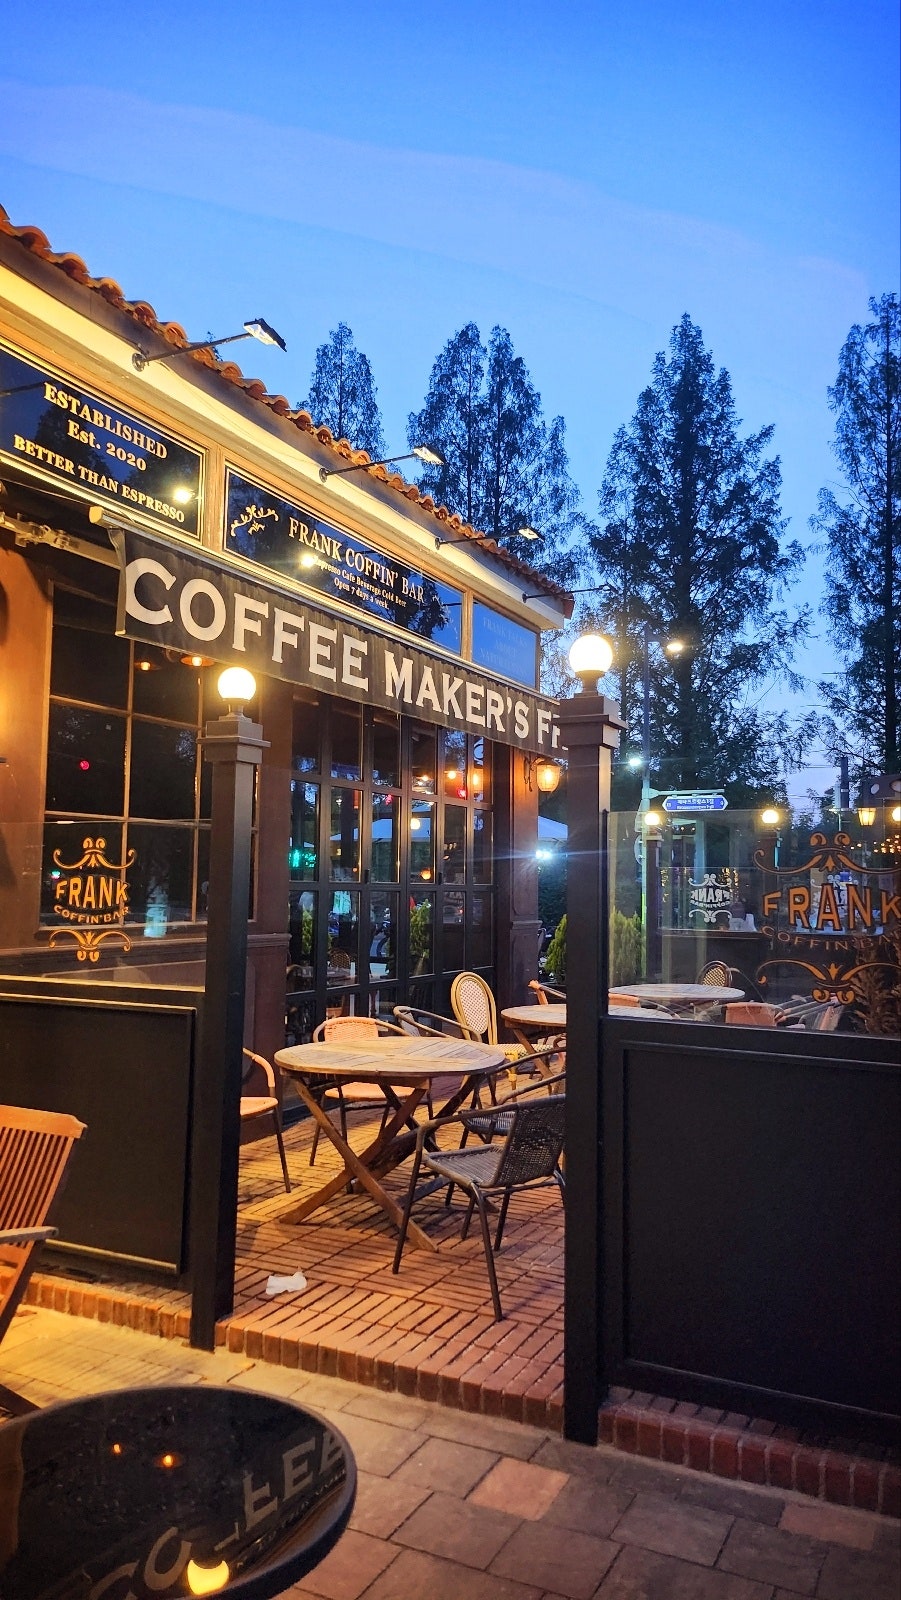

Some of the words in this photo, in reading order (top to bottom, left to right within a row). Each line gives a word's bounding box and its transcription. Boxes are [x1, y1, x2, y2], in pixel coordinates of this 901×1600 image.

[44, 382, 168, 459] ESTABLISHED
[67, 419, 101, 449] Est.
[106, 442, 147, 471] 2020
[13, 434, 76, 475] BETTER
[78, 465, 119, 494] THAN
[122, 484, 185, 523] ESPRESSO
[288, 517, 342, 562] FRANK
[345, 548, 398, 588] COFFIN'
[402, 576, 424, 604] BAR
[334, 577, 350, 591] Open
[125, 557, 369, 692] COFFEE
[384, 649, 530, 739] MAKER'S
[55, 876, 128, 909] FRANK
[763, 883, 901, 931] FRANK
